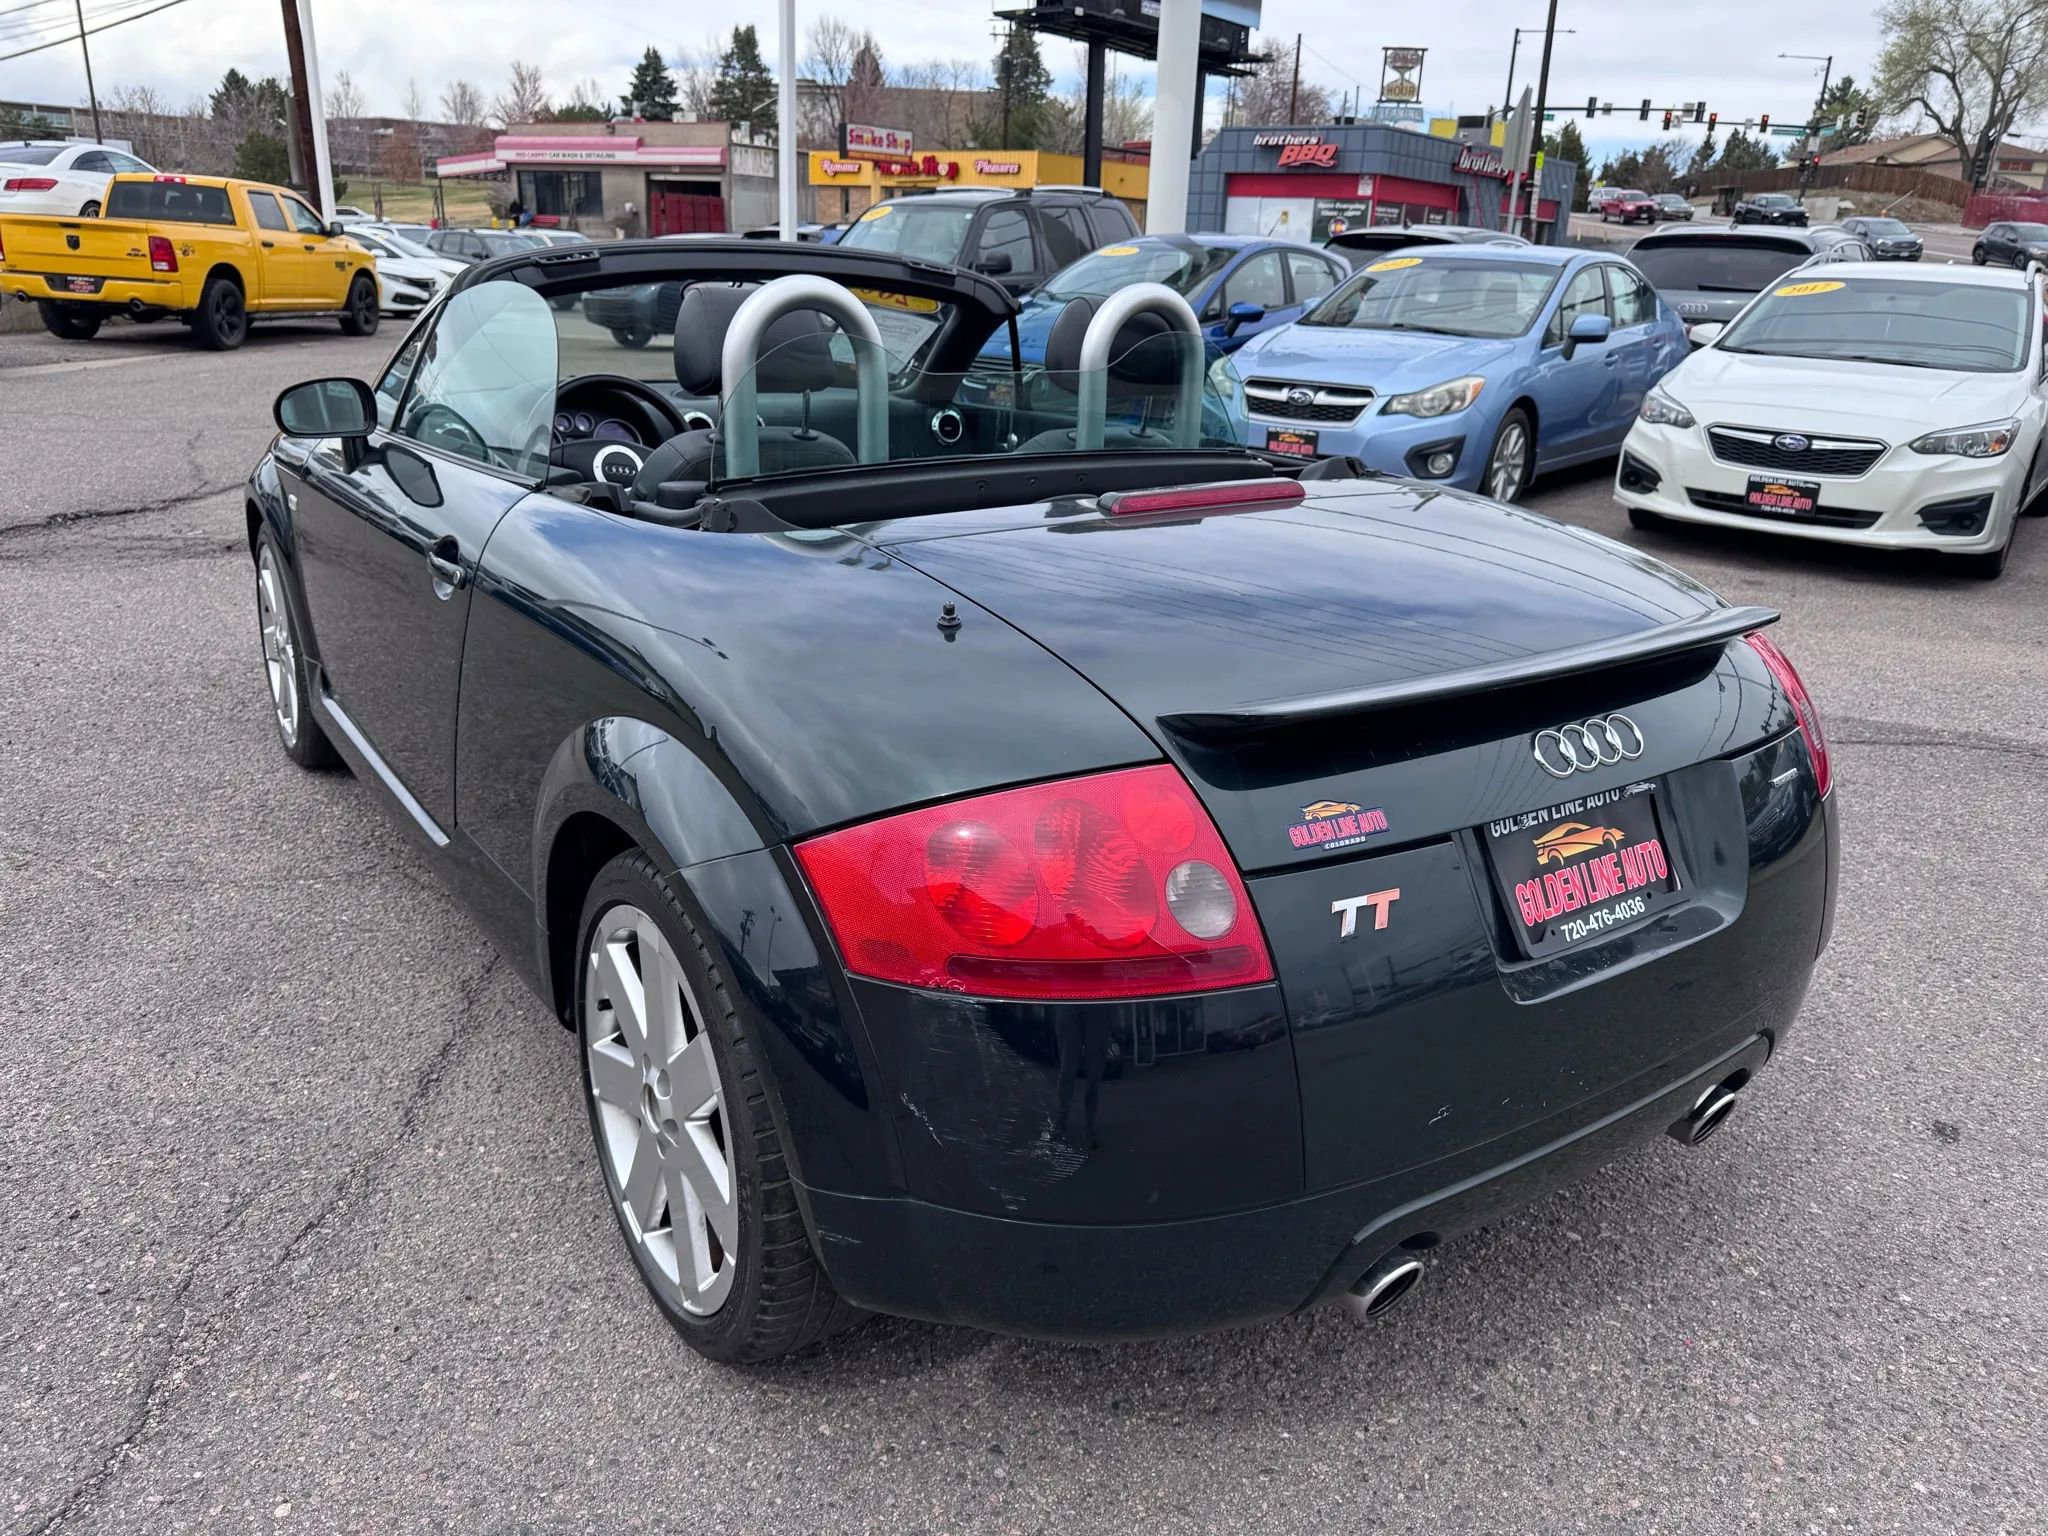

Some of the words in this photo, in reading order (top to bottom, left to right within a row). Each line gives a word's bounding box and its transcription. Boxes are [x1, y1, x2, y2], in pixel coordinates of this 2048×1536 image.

[1387, 86, 1415, 97] HOUR
[886, 132, 911, 155] Shop
[1253, 134, 1320, 146] brothers
[922, 155, 959, 180] Shop
[1278, 144, 1339, 167] BBQ
[1748, 491, 1777, 505] GOLDEN
[1776, 494, 1793, 508] LINE
[1792, 497, 1813, 511] AUTO
[1551, 799, 1584, 819] LINE
[1586, 788, 1620, 809] AUTO
[1289, 820, 1335, 848] GOLDEN
[1332, 815, 1360, 839] LINE
[1358, 810, 1388, 833] AUTO
[1324, 835, 1366, 850] COLORADO
[1515, 865, 1586, 927] GOLDEN
[1581, 852, 1625, 904] LINE
[1620, 838, 1668, 890] AUTO
[1332, 888, 1400, 937] TT
[1560, 896, 1646, 942] 720-476-4036
